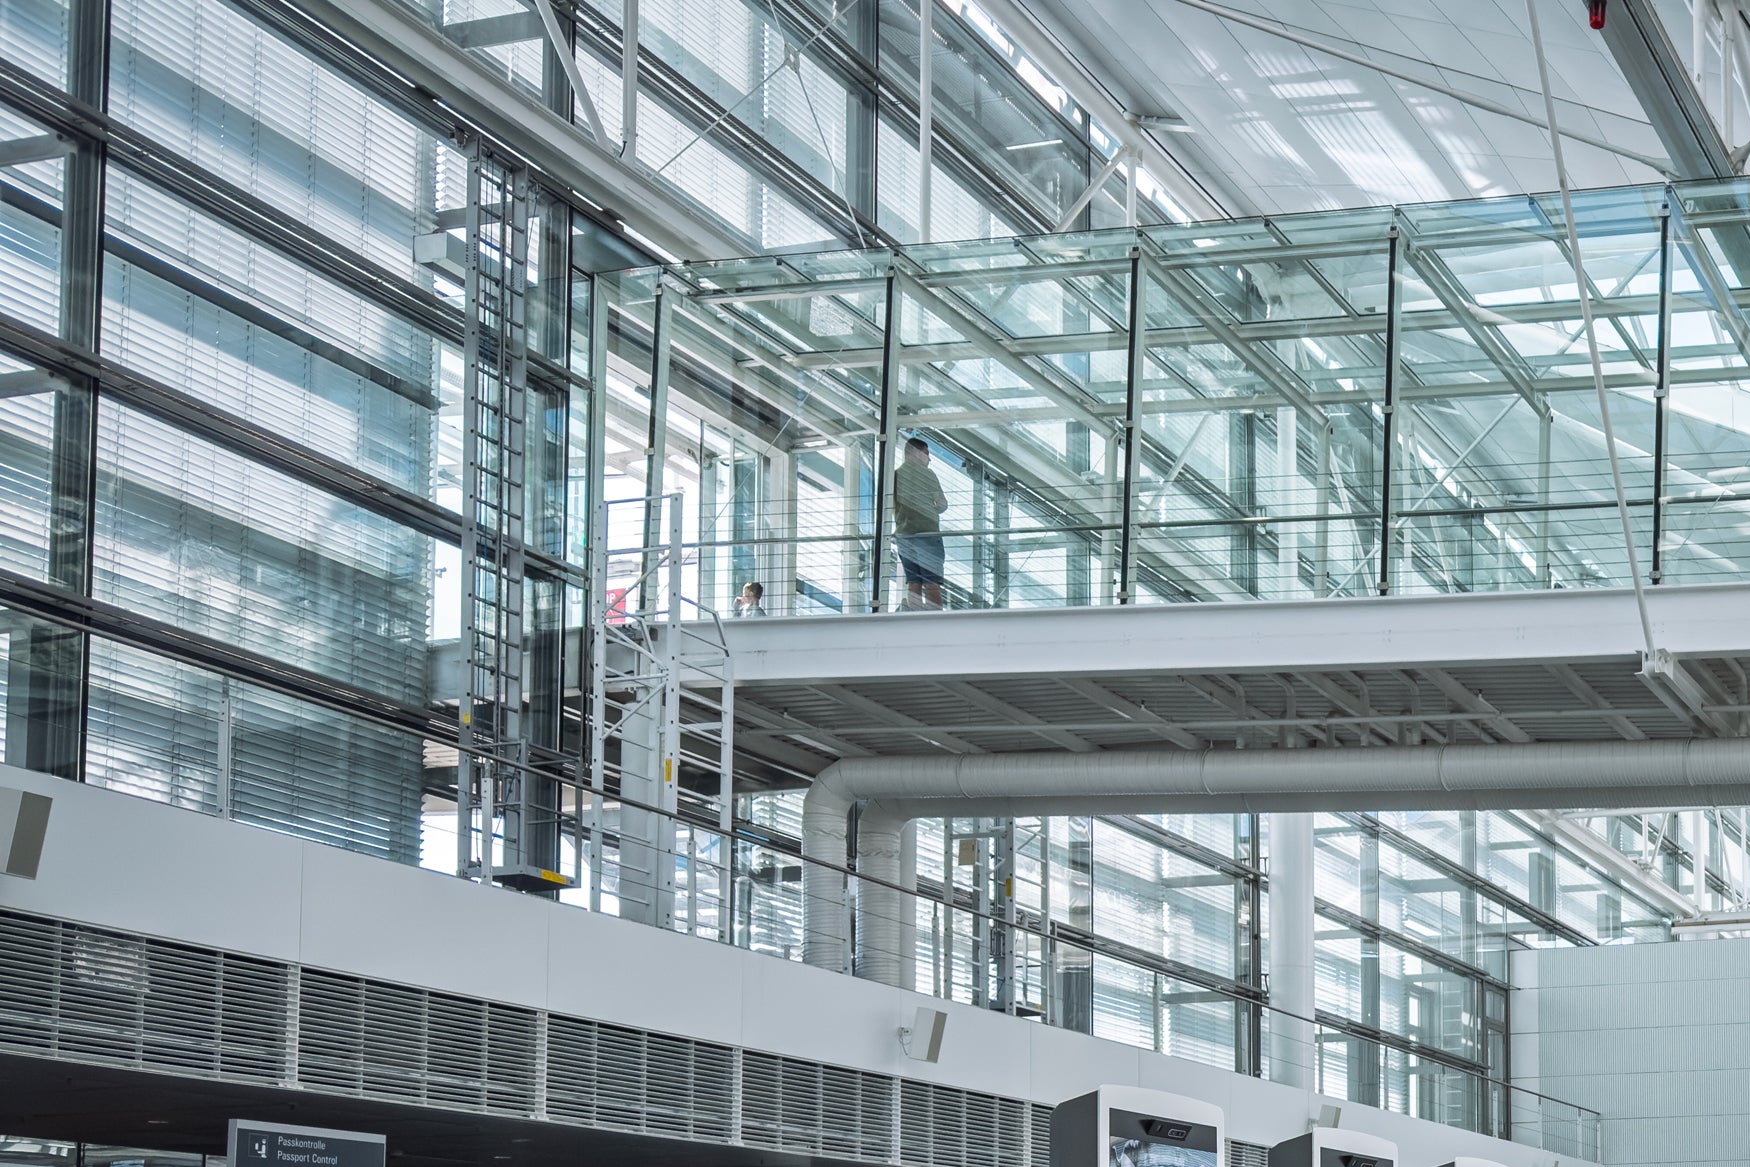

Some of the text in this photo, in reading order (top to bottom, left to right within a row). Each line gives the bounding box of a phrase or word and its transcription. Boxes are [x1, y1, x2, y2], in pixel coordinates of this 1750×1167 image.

[277, 1135, 326, 1150] Passkontrolle
[277, 1150, 338, 1165] Passport Control
